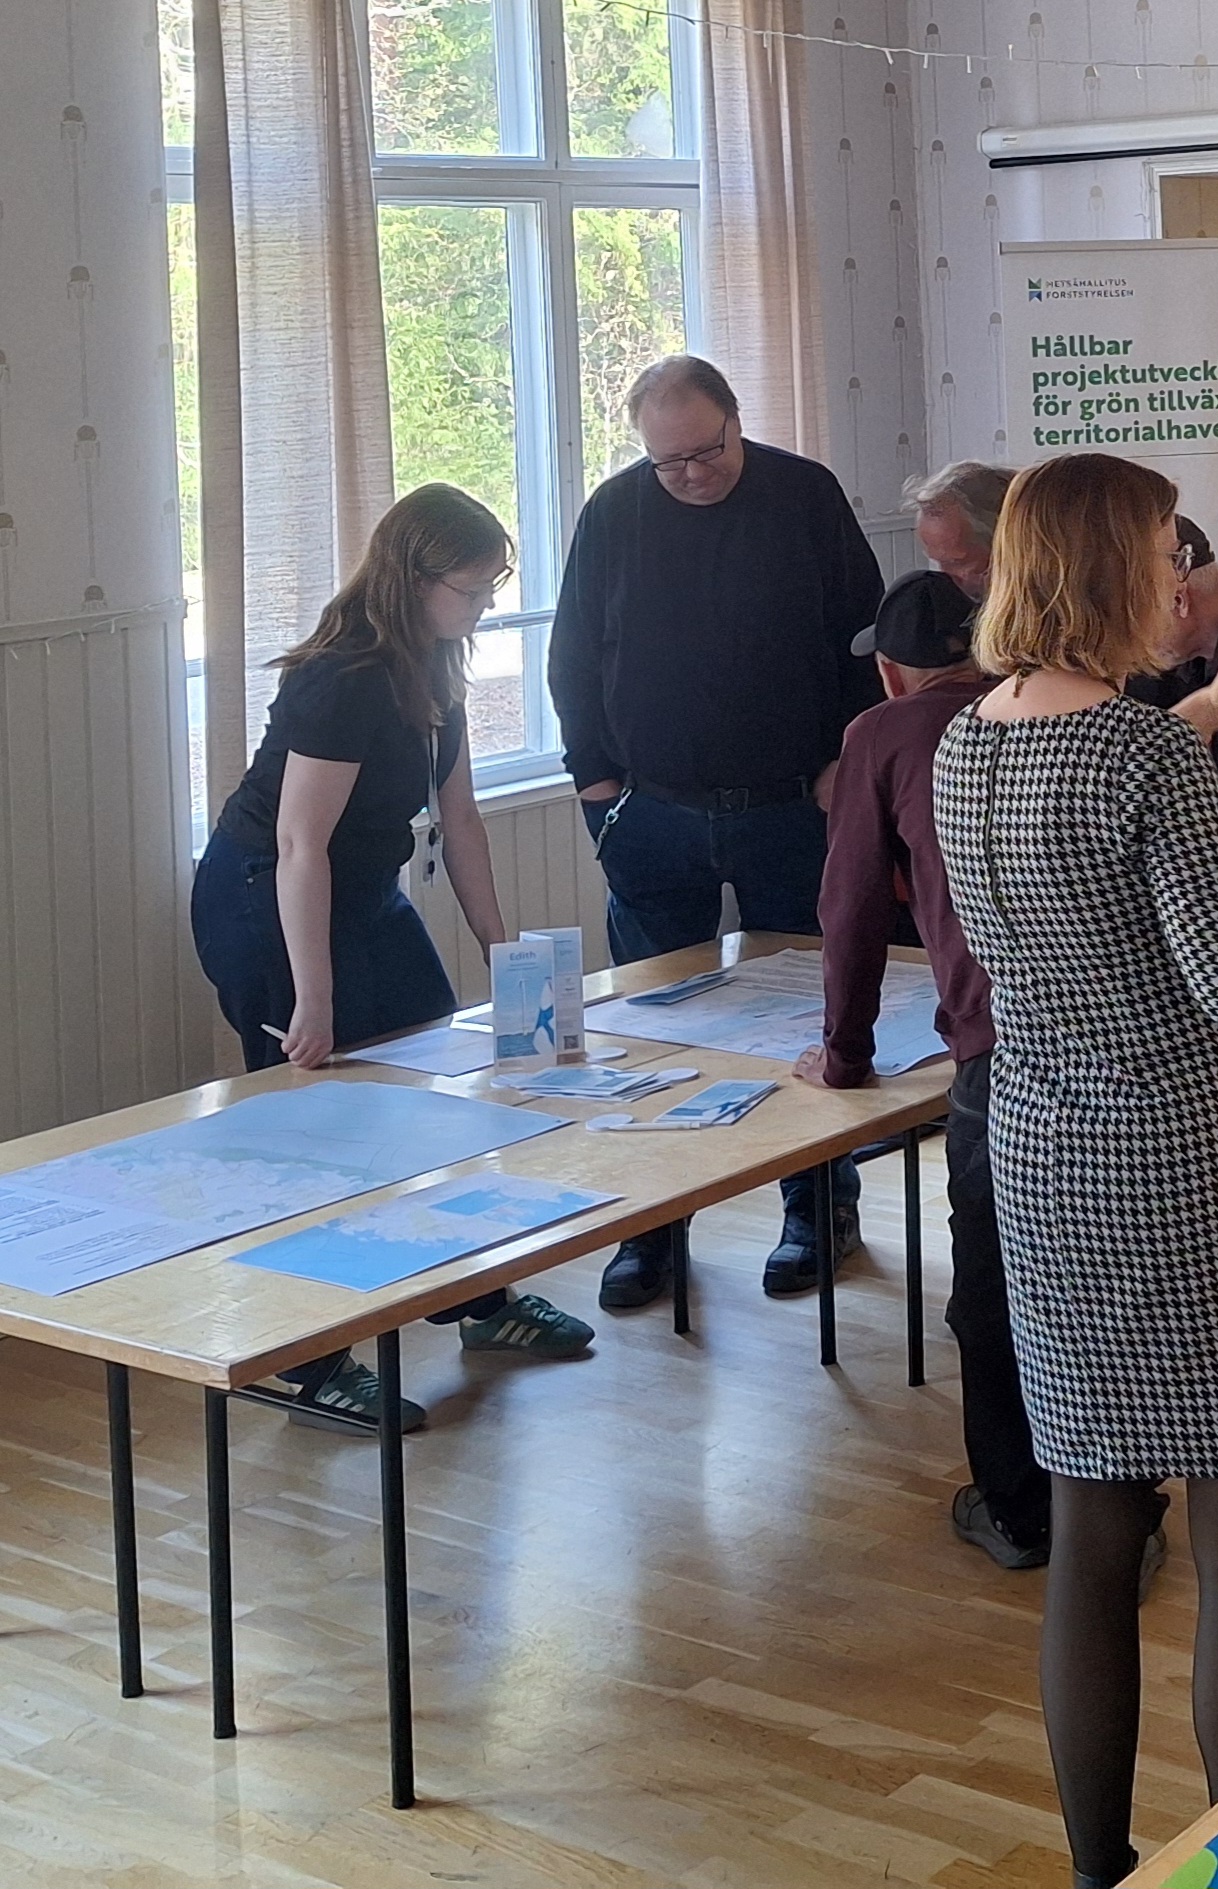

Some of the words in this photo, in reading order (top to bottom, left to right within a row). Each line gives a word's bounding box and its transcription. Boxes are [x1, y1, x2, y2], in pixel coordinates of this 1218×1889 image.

[1046, 289, 1134, 299] FORSTSTYRELSEN
[1031, 334, 1133, 358] Hållbar
[1033, 394, 1072, 417] för
[1079, 391, 1140, 421] grön
[509, 951, 537, 961] Edith
